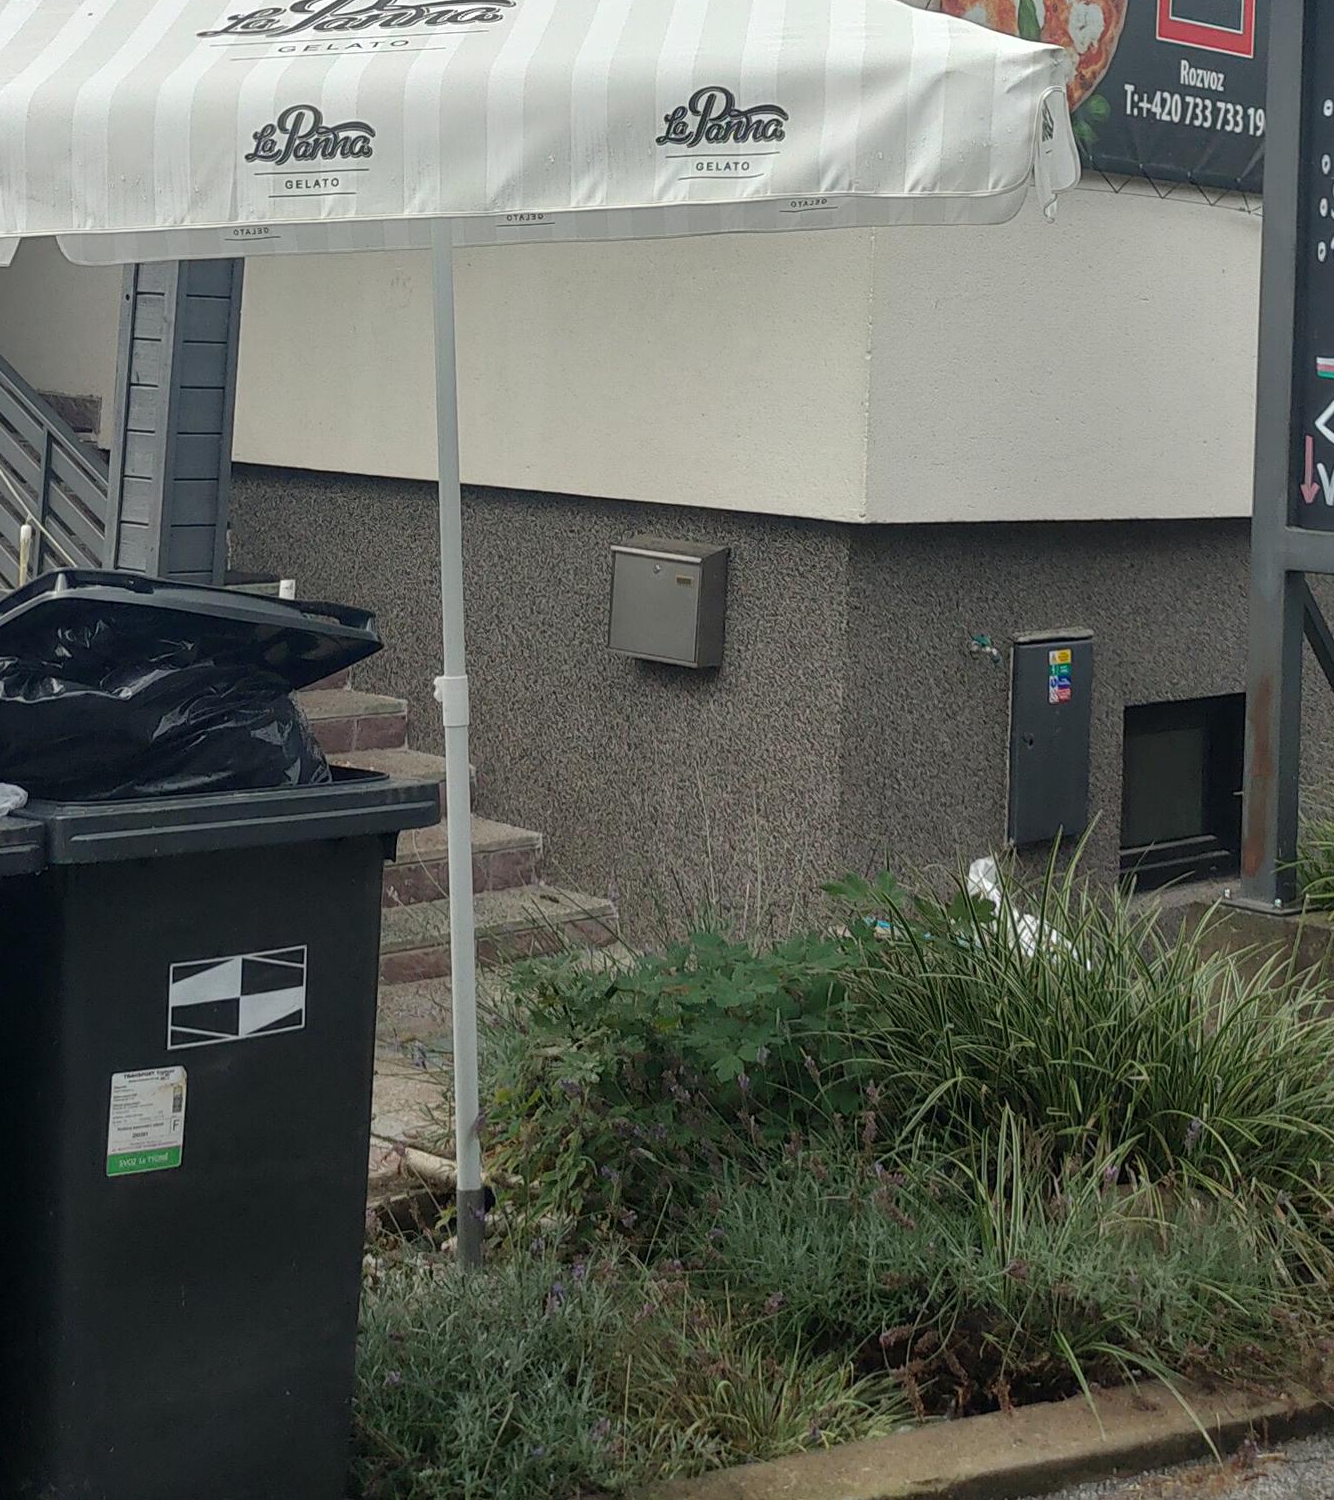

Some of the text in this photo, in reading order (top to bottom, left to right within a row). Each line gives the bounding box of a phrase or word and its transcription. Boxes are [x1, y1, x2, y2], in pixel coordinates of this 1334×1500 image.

[196, 7, 288, 38] La
[278, 40, 410, 53] GELATO
[1180, 60, 1224, 91] Rozvoz
[656, 86, 789, 148] La Panna
[1124, 84, 1265, 137] T:+420 733 733 19
[244, 104, 376, 165] La Panna
[696, 162, 750, 171] GELATO
[285, 178, 340, 190] GELATO
